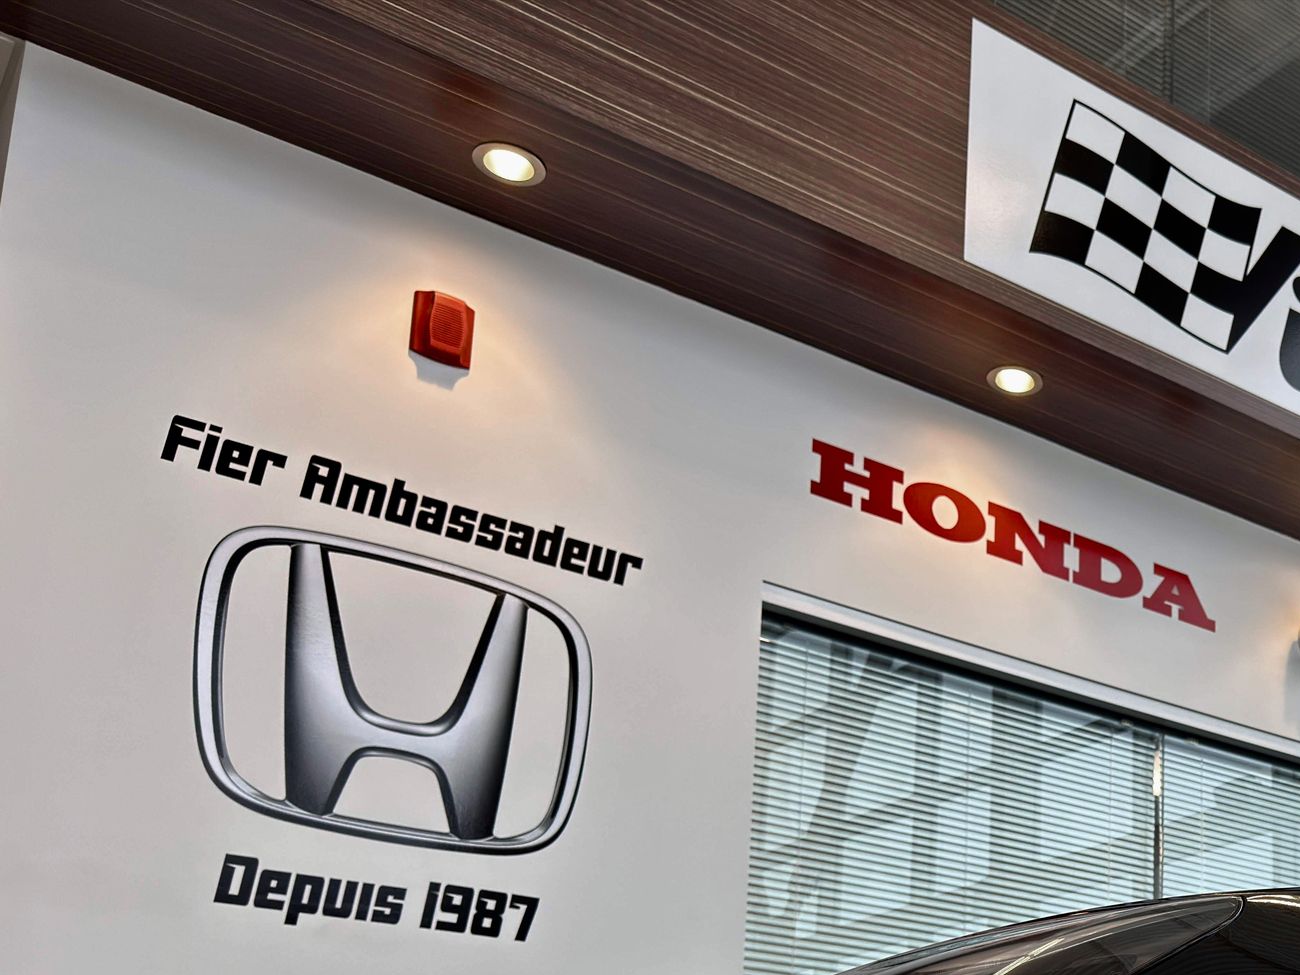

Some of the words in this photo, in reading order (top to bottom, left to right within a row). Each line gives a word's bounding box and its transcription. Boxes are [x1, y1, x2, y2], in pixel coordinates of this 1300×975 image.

[160, 414, 288, 486] Fier
[299, 454, 644, 586] Ambassadeur
[810, 438, 1216, 633] HONDA
[213, 853, 407, 926] Depuis
[419, 881, 540, 942] 1987
